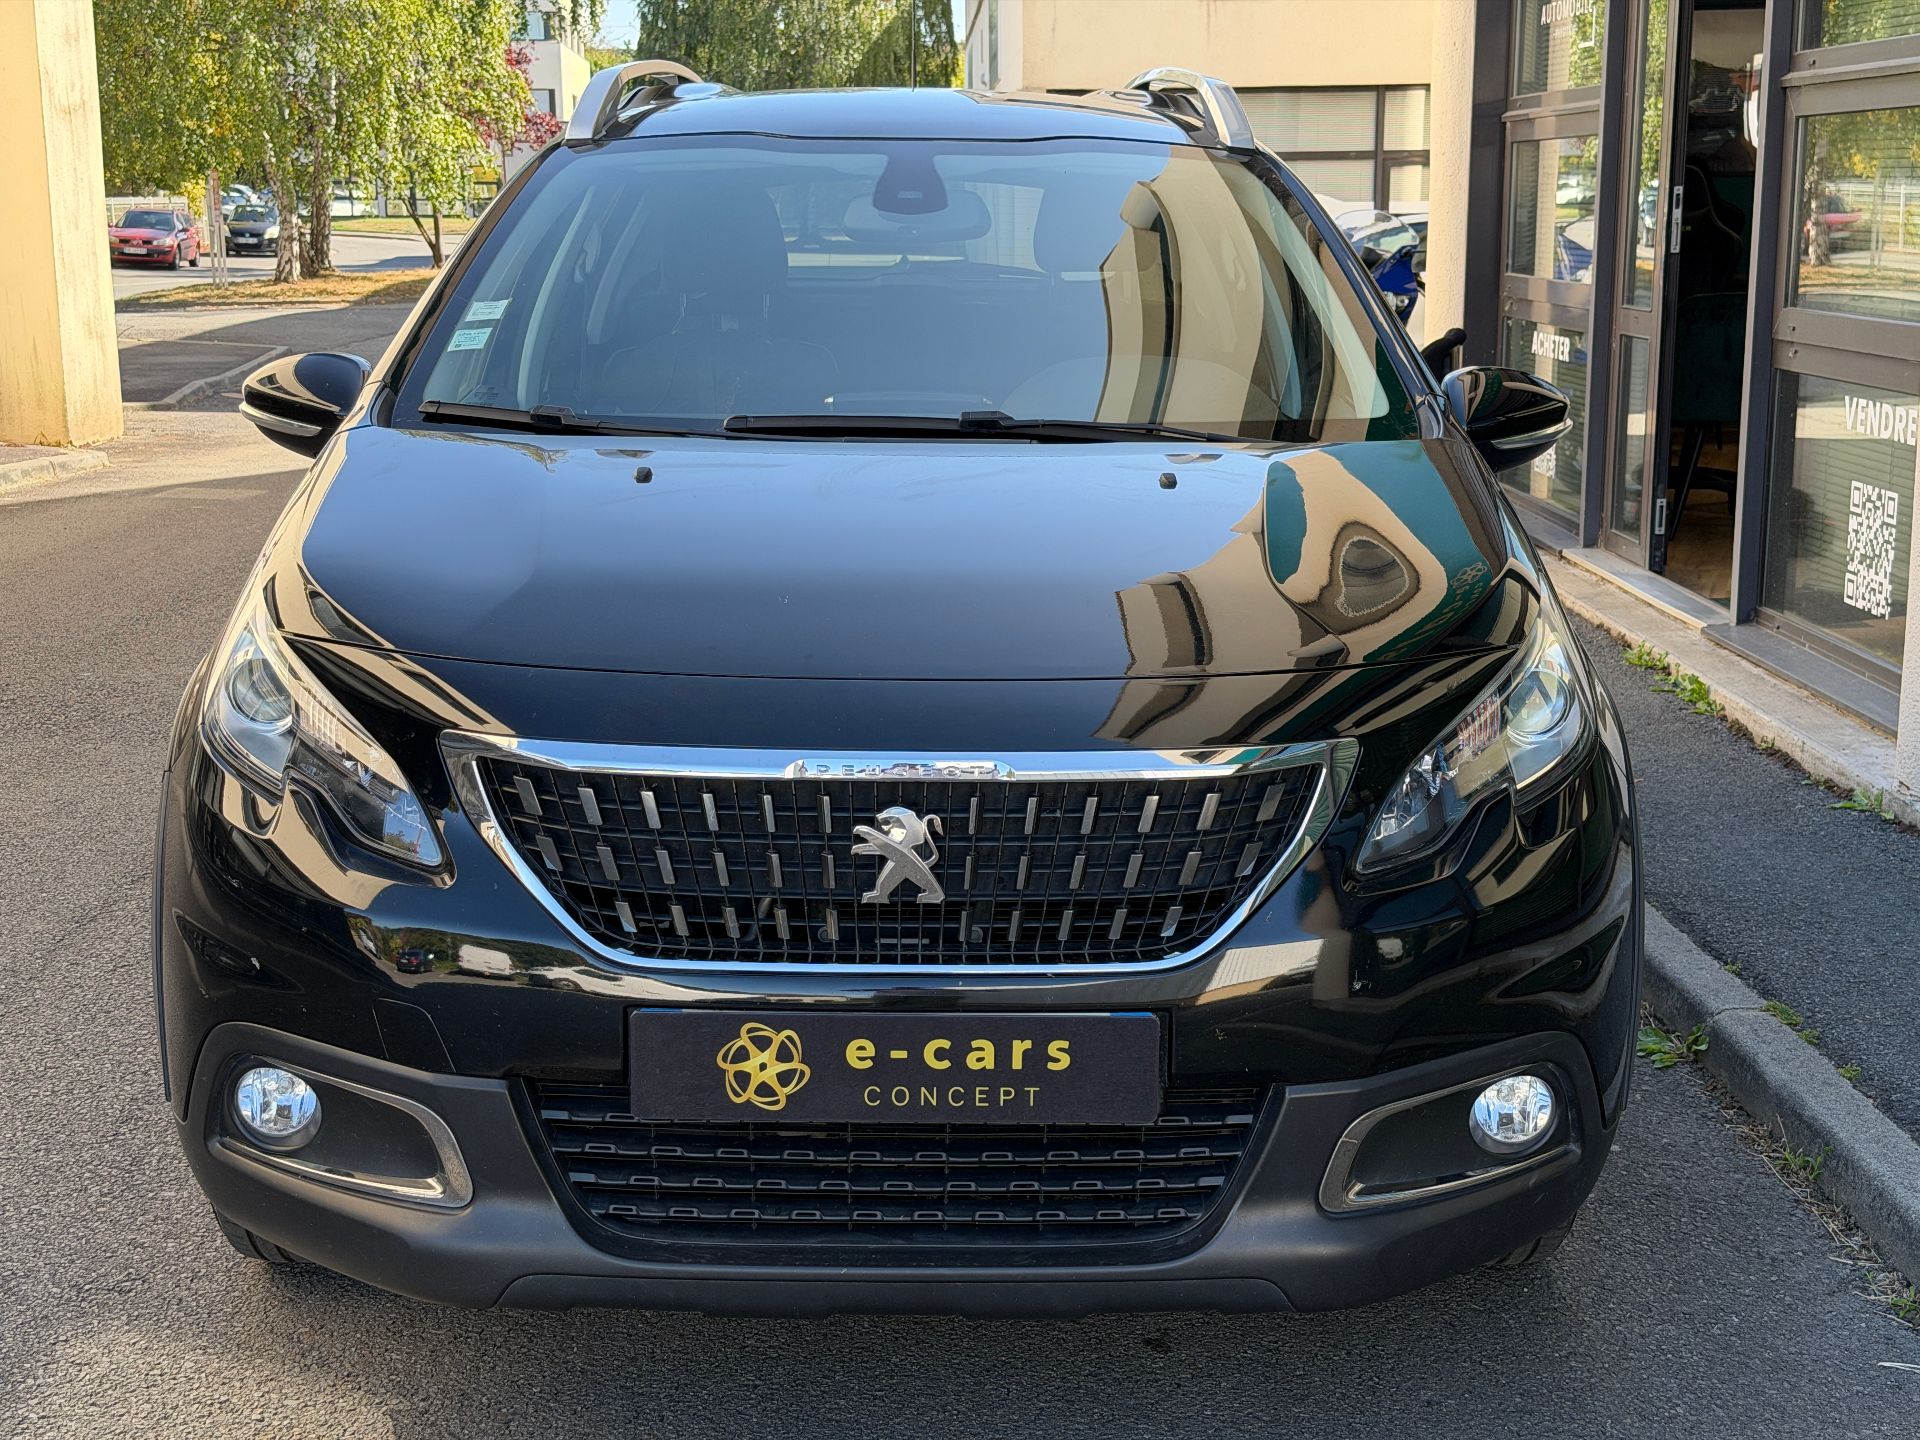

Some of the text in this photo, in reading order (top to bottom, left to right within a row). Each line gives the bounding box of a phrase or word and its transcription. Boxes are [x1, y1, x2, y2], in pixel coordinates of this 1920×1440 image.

[1541, 0, 1593, 25] AUTOMOBILE
[1531, 330, 1570, 362] ACHETER
[1845, 395, 1917, 446] VENDRE
[816, 763, 986, 778] PEUGEOT
[846, 1038, 1072, 1071] e-cars
[864, 1086, 1041, 1107] CONCEPT
